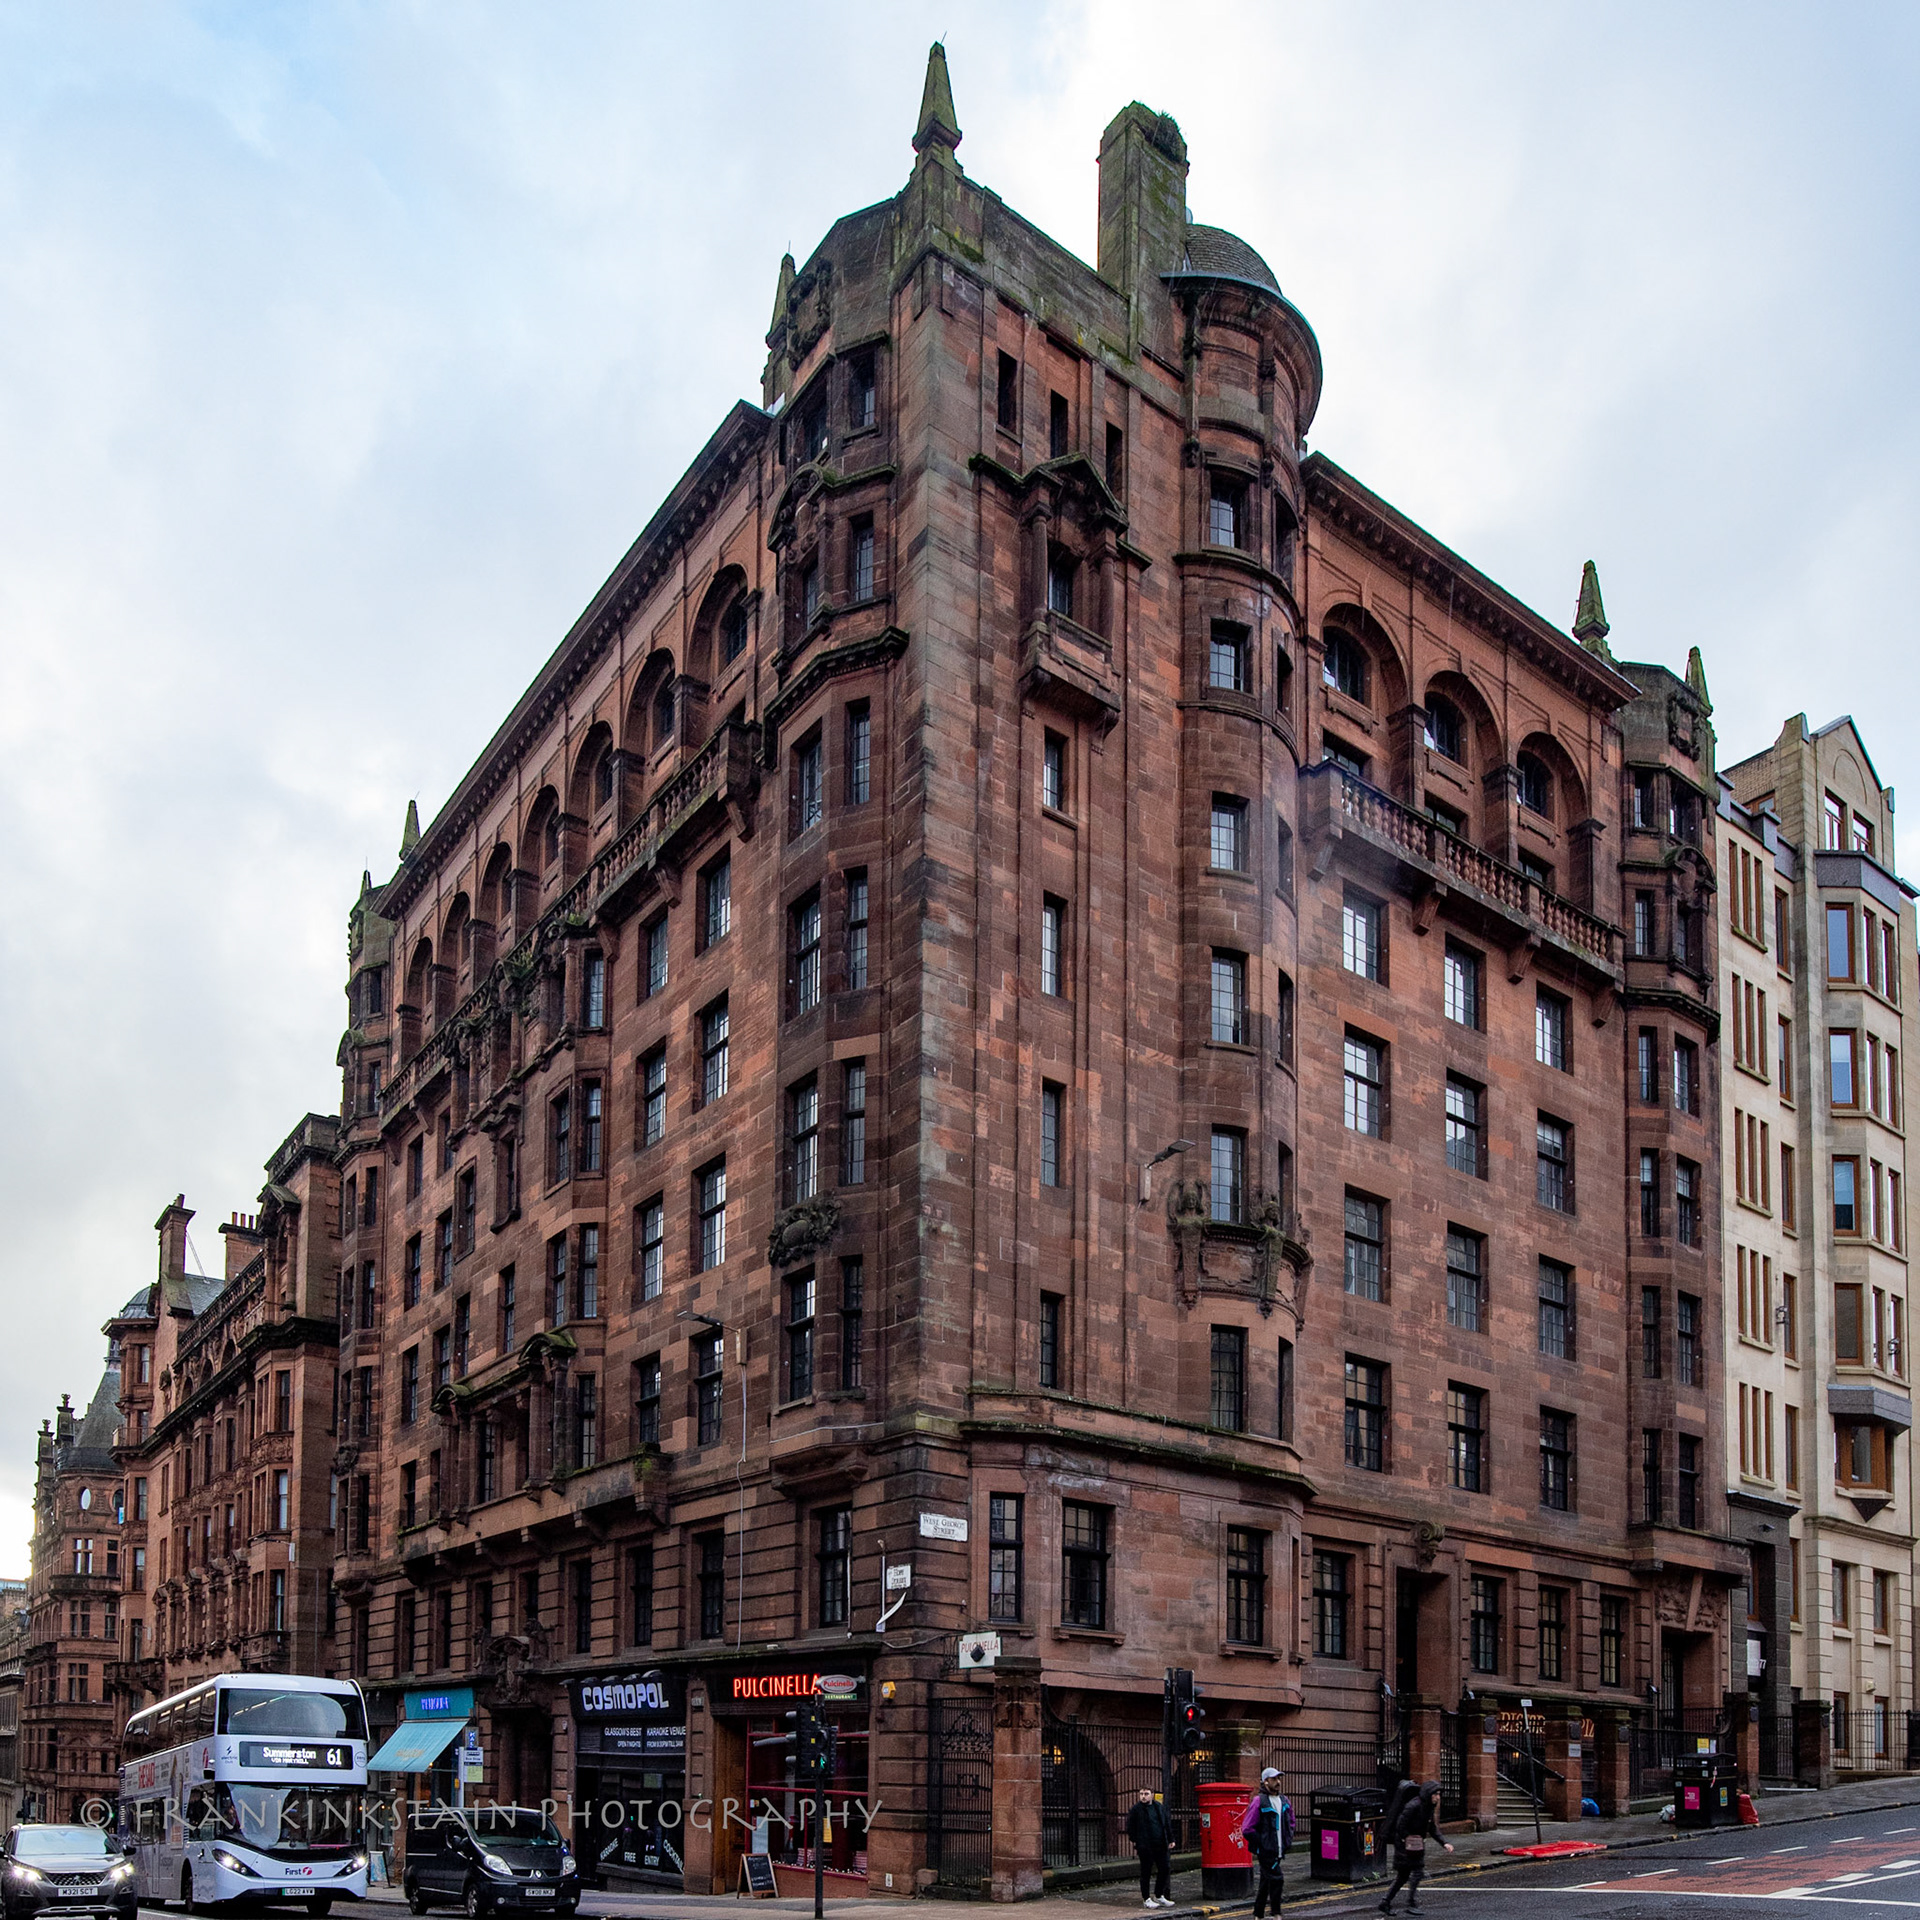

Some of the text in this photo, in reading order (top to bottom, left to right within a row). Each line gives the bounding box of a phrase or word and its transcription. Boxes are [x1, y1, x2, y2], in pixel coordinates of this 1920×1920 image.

[733, 1673, 822, 1698] PULCINELLA
[823, 1679, 855, 1688] Pulcinella
[582, 1682, 670, 1711] COSMOPOL
[630, 1727, 642, 1737] BEST
[263, 1746, 342, 1765] Summerston 61
[624, 1851, 637, 1863] FREE
[285, 1867, 302, 1875] First
